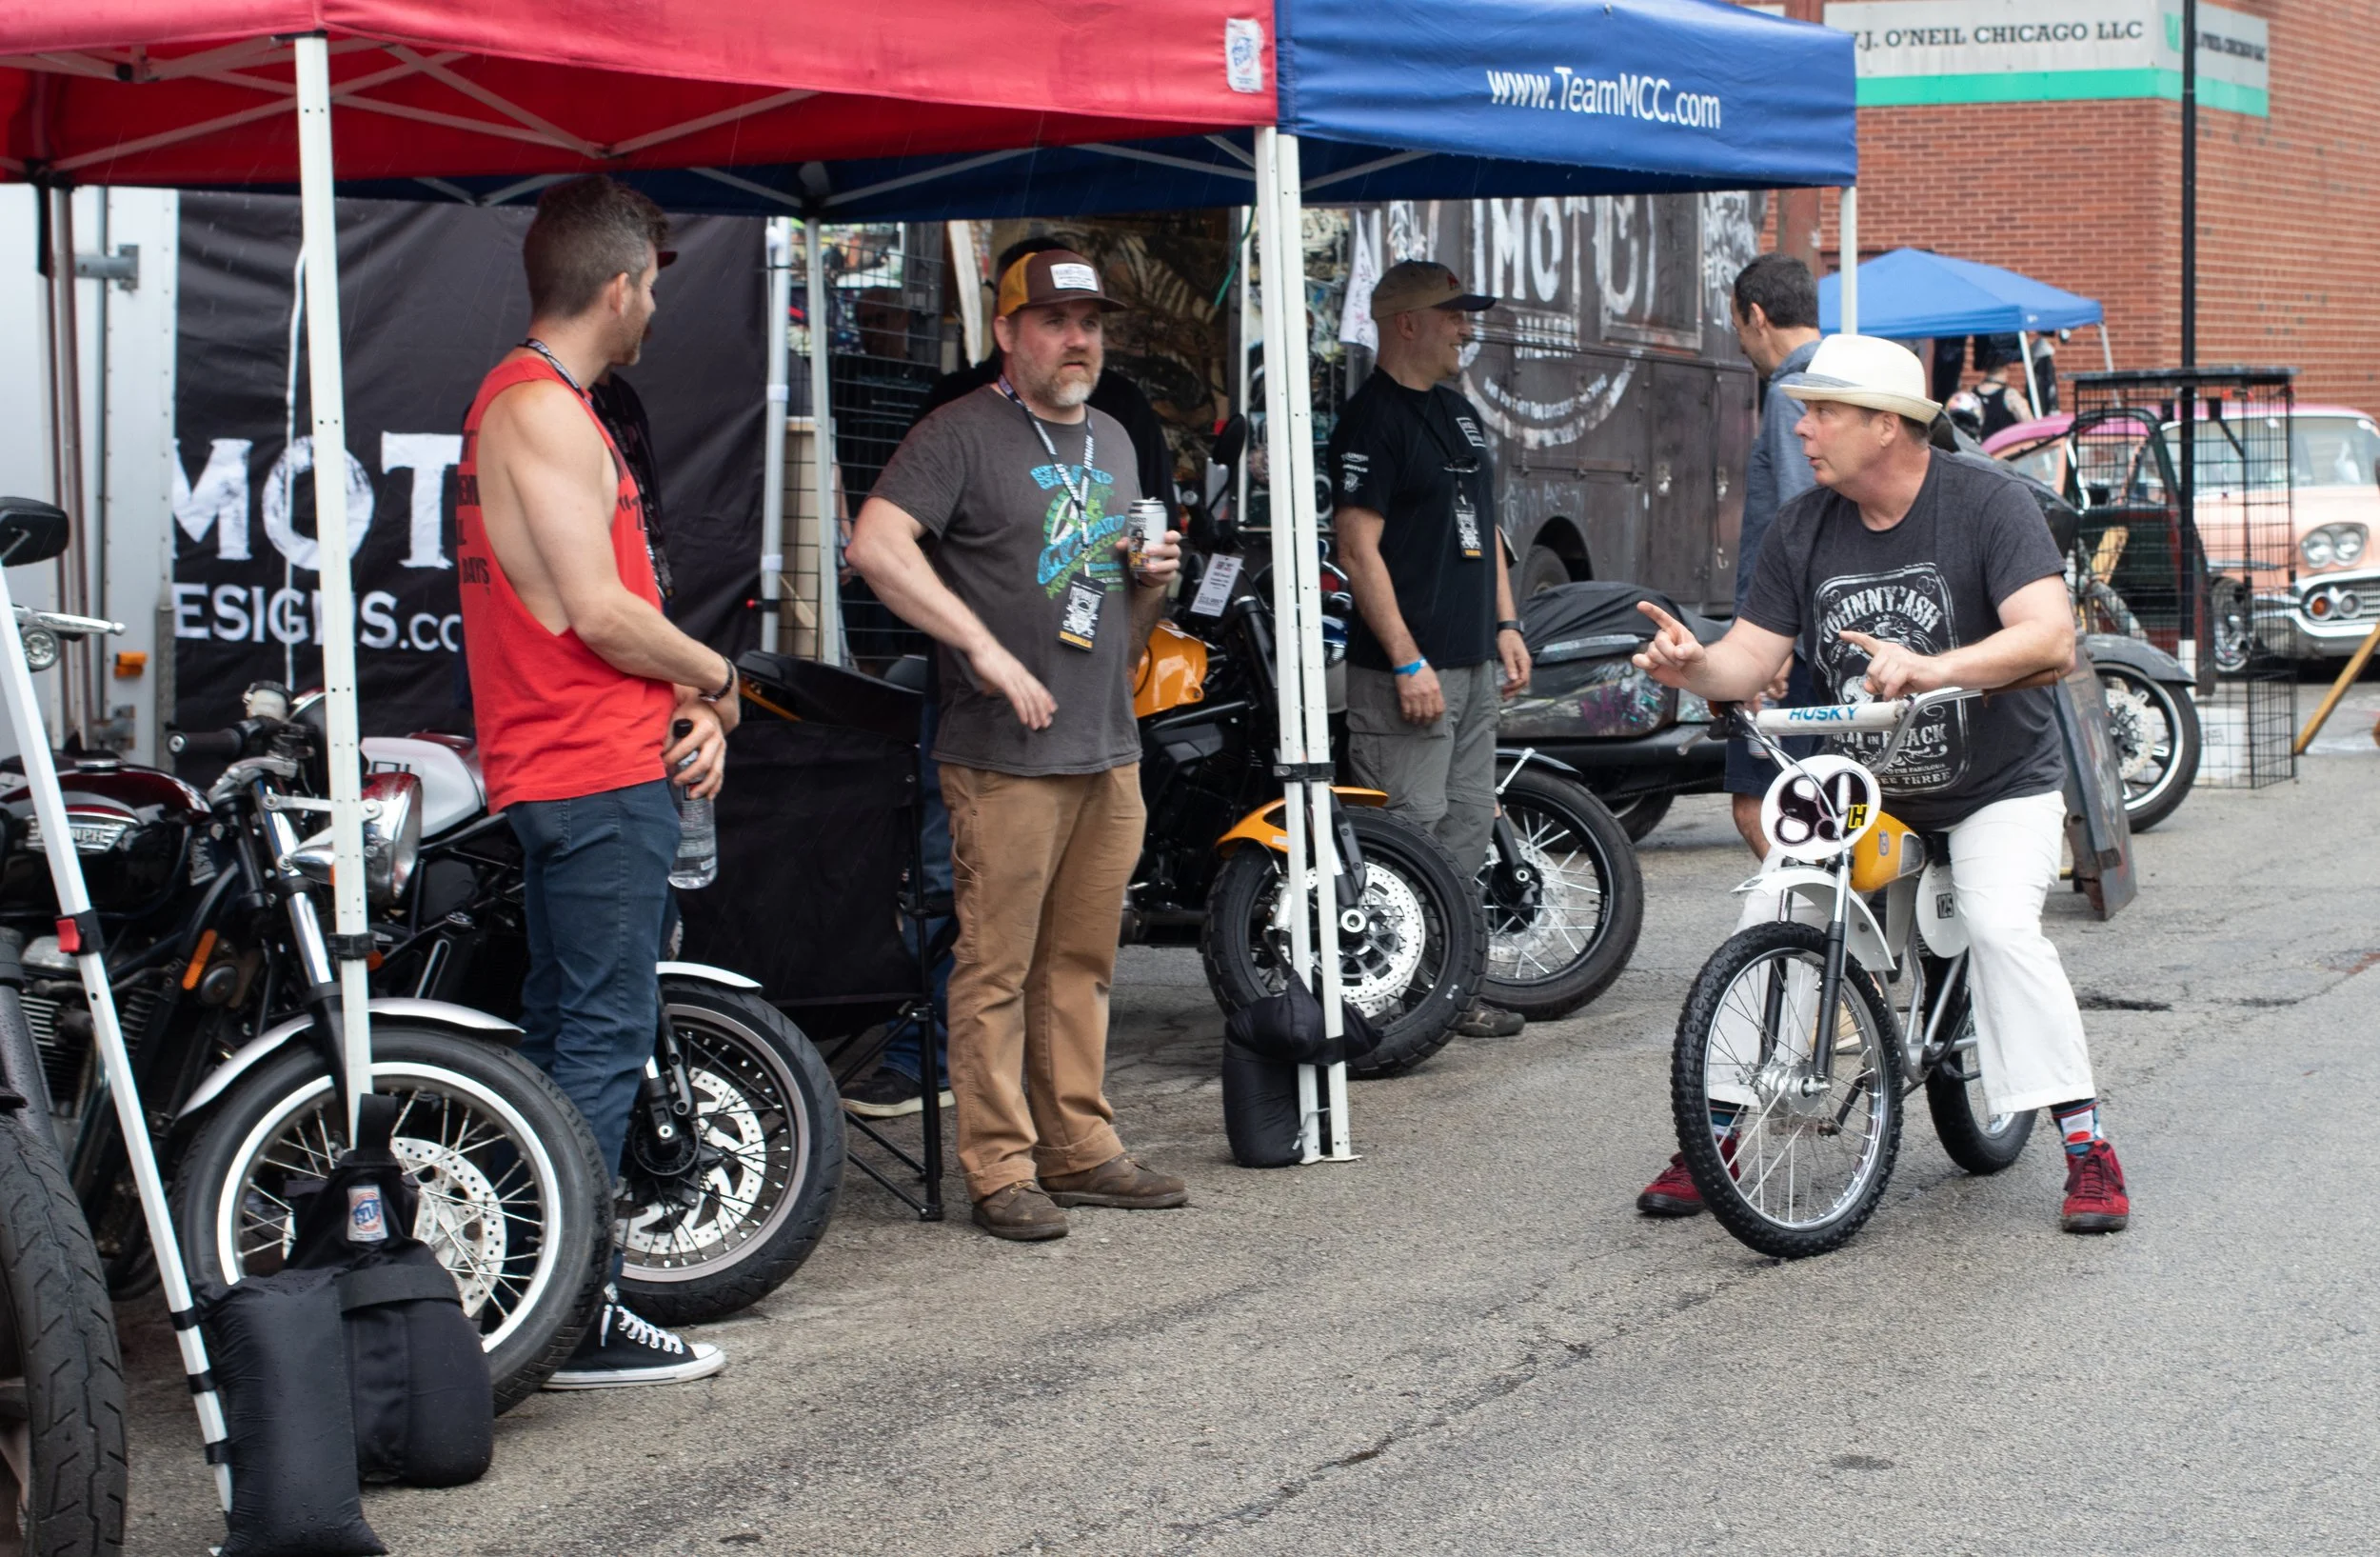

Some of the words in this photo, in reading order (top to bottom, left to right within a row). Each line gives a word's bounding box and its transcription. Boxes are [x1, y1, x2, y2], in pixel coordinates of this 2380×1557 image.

[1885, 26, 1967, 48] O'NEIL
[1973, 22, 2089, 44] CHICAGO
[2097, 21, 2143, 40] LLC
[1486, 66, 1721, 130] www.TeamMCC.com
[1789, 706, 1859, 721] HUSKY
[1902, 771, 1951, 785] THREE
